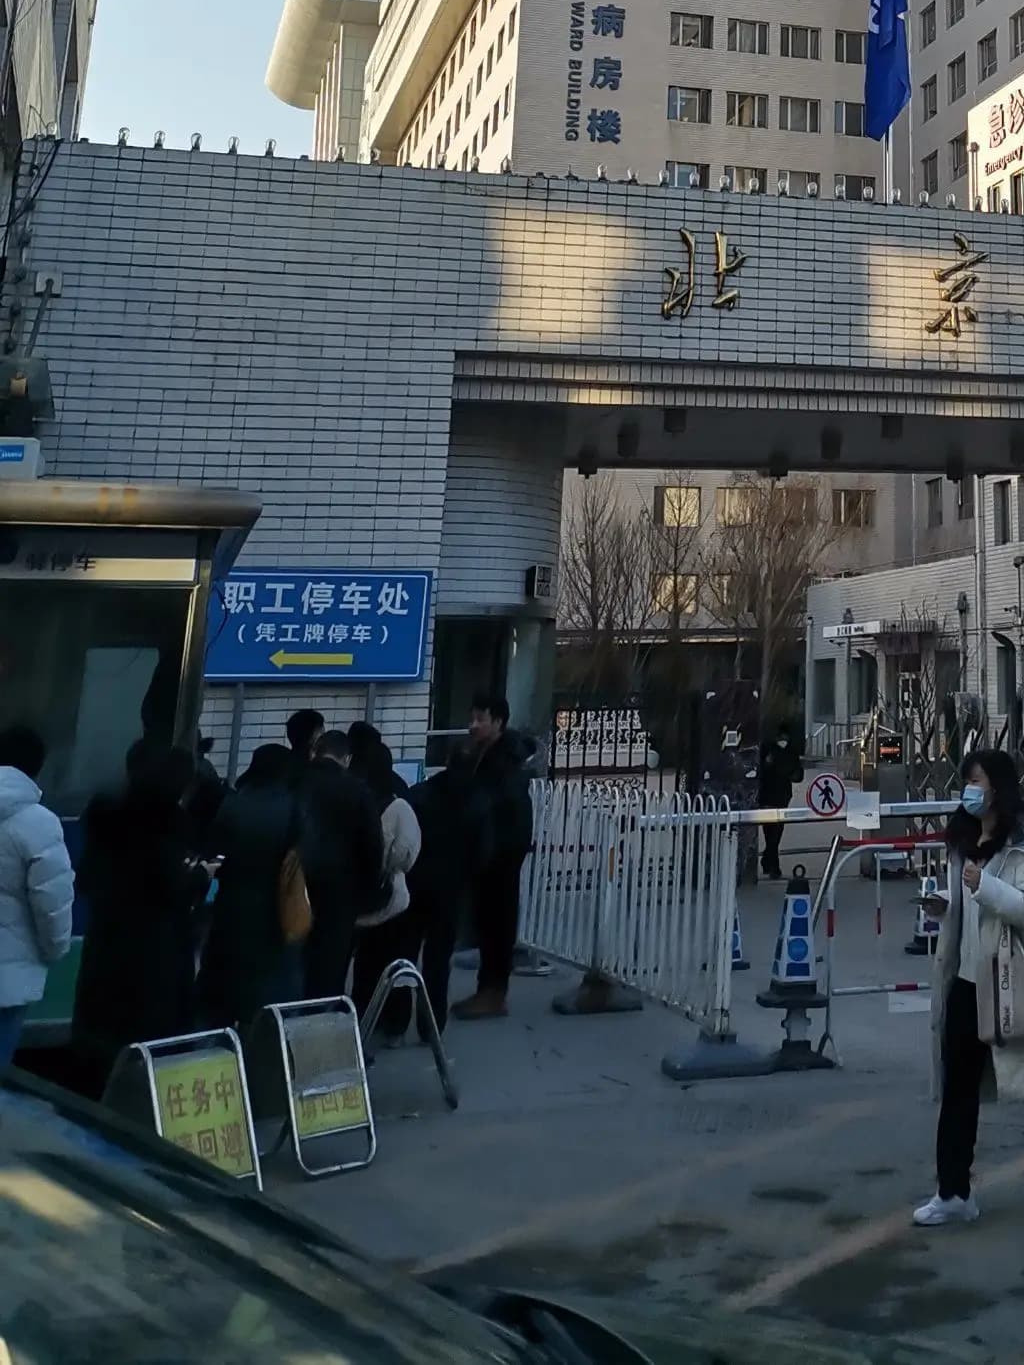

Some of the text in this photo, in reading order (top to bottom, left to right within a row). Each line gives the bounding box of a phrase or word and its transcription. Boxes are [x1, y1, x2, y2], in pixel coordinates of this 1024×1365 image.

[565, 1, 585, 141] WARD BUILDING
[586, 4, 626, 144] 病房楼
[222, 581, 410, 616] 职工停车处
[166, 1072, 236, 1121] 任务中
